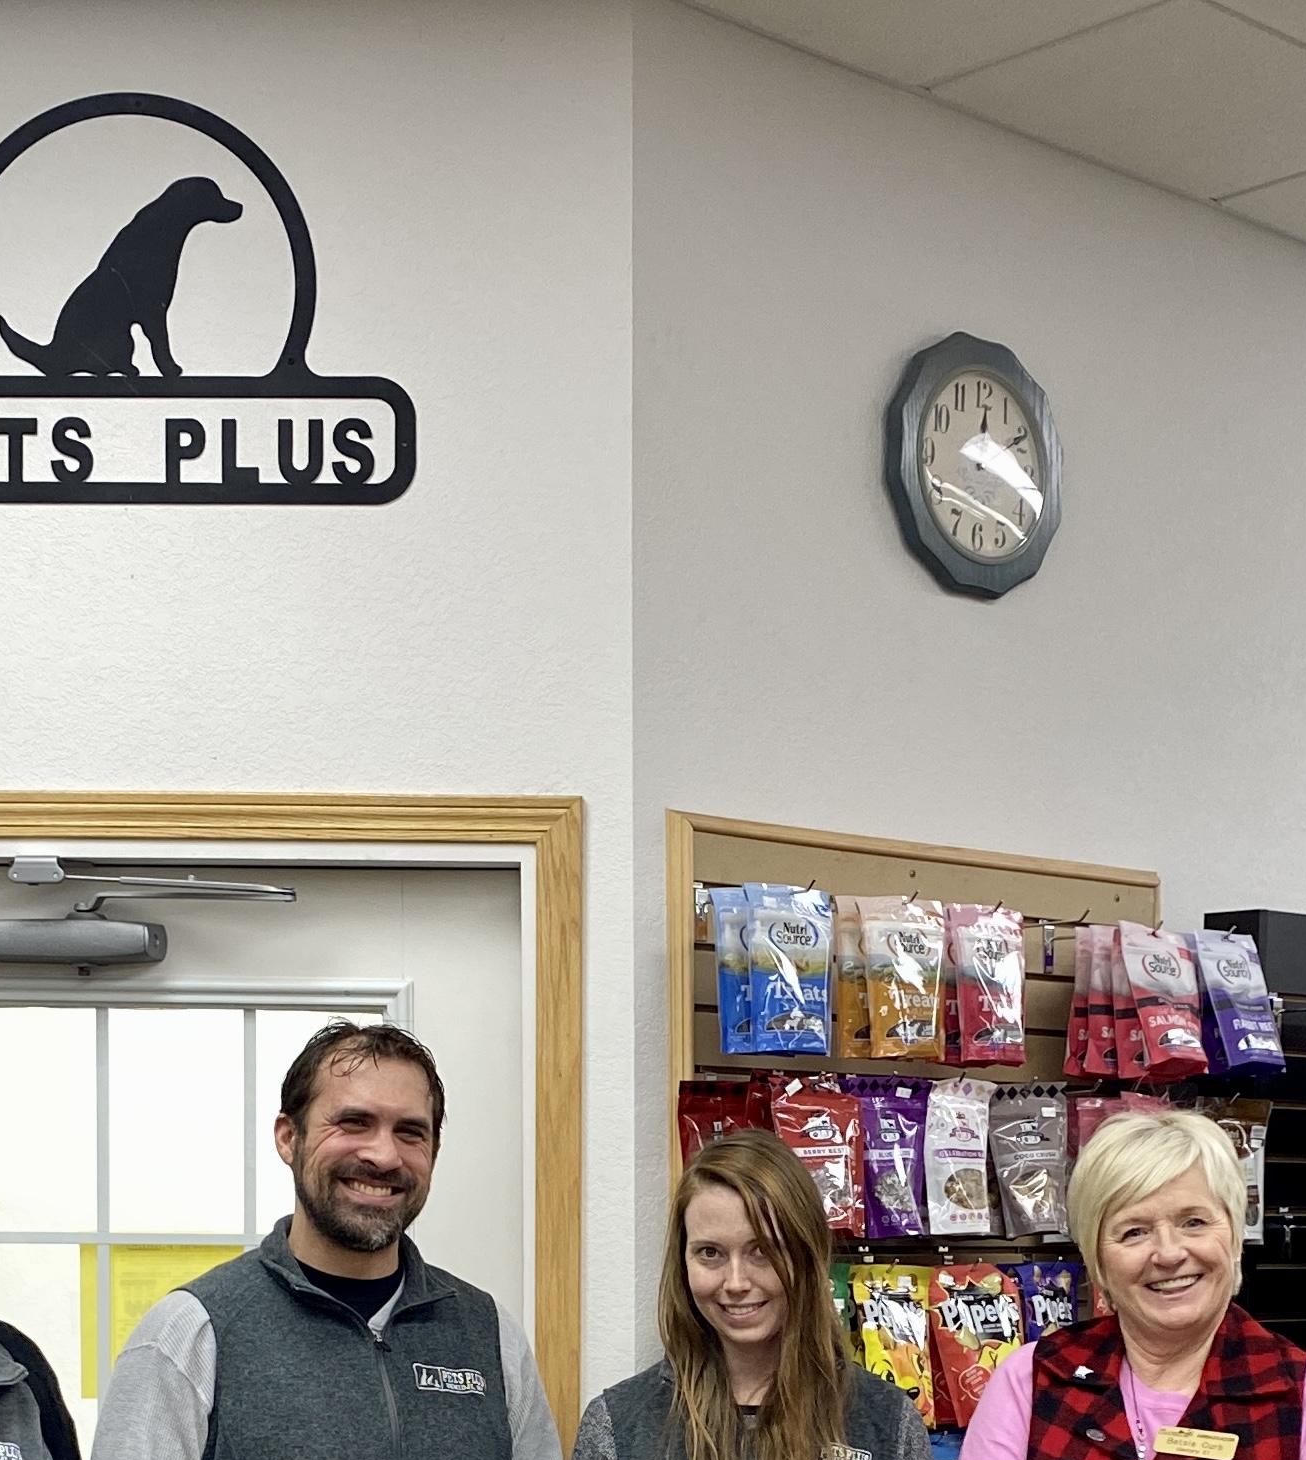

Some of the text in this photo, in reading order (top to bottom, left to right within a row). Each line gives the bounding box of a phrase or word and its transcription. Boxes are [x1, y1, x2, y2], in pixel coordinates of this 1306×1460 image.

[954, 382, 966, 412] 11
[975, 380, 993, 411] 12
[933, 403, 950, 434] 10
[1003, 396, 1009, 425] 1
[165, 418, 376, 486] PLUS
[922, 437, 935, 466] 9
[951, 508, 963, 537] 7
[1012, 498, 1024, 526] 4
[971, 521, 983, 550] 6
[995, 521, 1006, 548] 5
[776, 931, 812, 946] Source
[782, 921, 807, 935] Nutri
[1149, 962, 1176, 977] Source
[1152, 954, 1172, 967] Nutri
[442, 1371, 464, 1385] PETS
